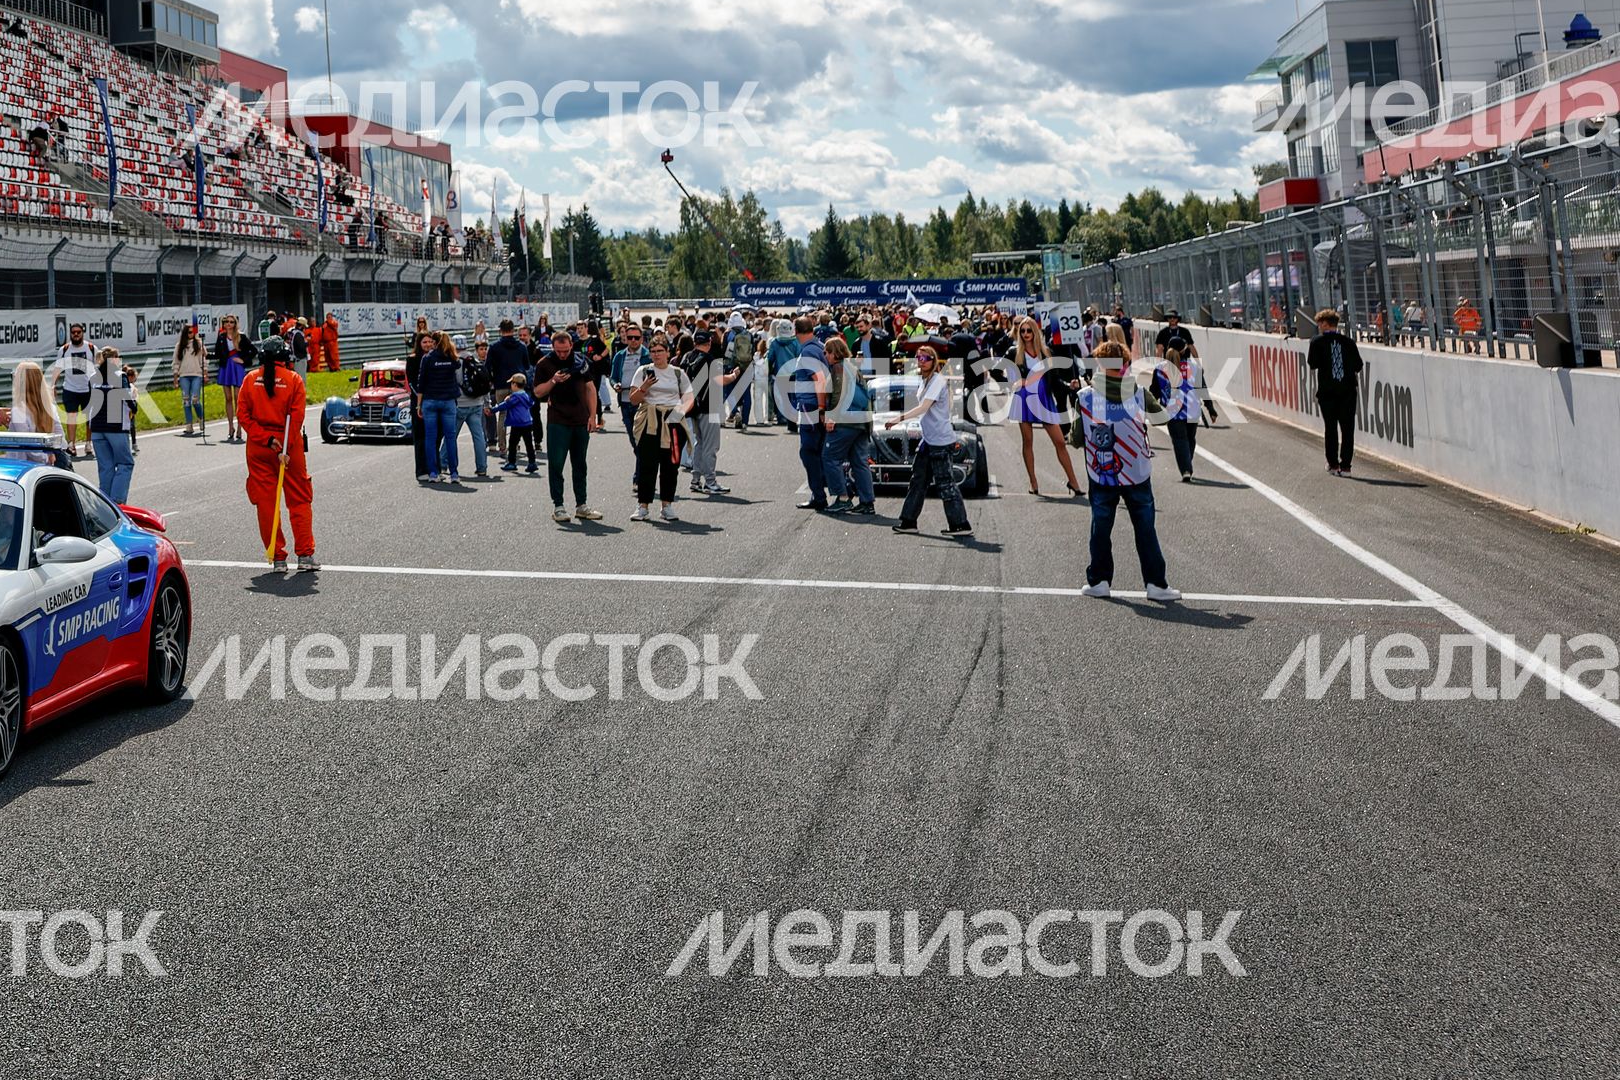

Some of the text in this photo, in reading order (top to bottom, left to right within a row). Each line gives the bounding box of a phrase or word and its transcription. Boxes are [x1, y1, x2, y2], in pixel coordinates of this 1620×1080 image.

[747, 287, 795, 295] SMP RACING
[817, 285, 867, 294] SMP RACING
[890, 284, 942, 294] SMP RACING
[967, 283, 1020, 292] SMP RACING
[198, 314, 210, 325] 221
[1060, 315, 1080, 331] 33
[89, 318, 123, 340] СЕЙФОВ
[147, 316, 188, 337] МИР СЕЙФ
[45, 583, 87, 612] LEADING CAR
[58, 596, 120, 647] SMP RACING
